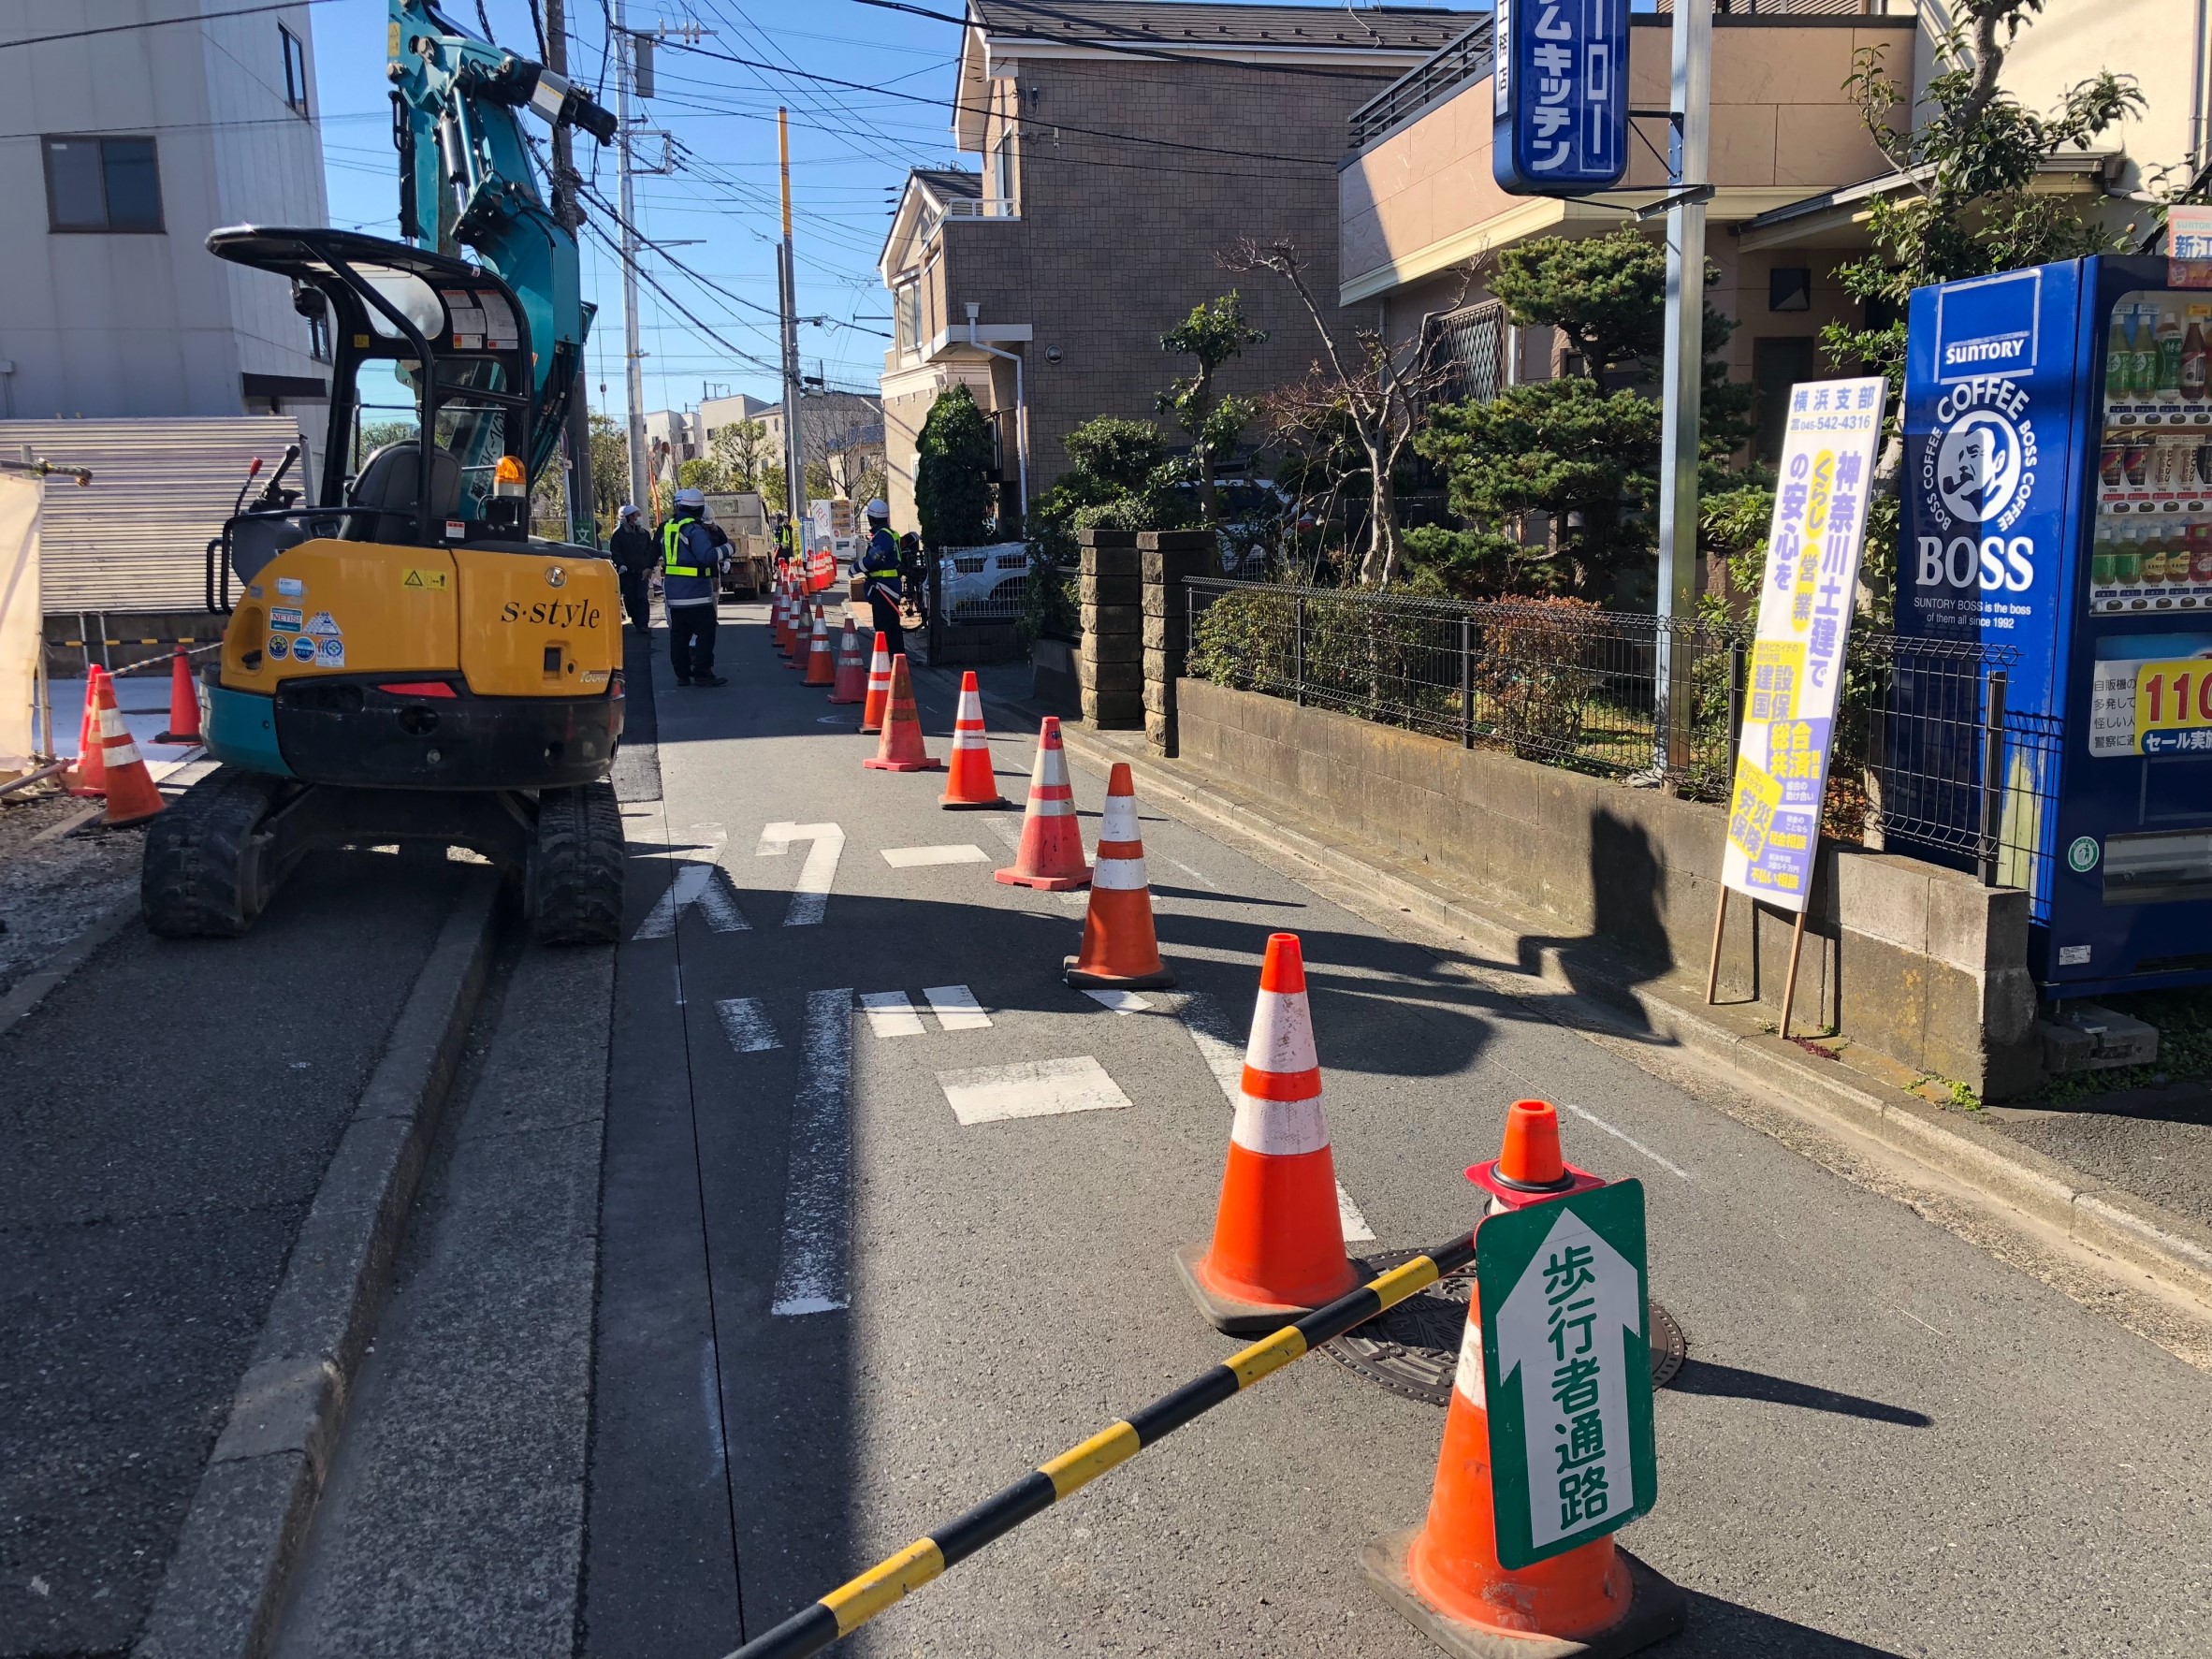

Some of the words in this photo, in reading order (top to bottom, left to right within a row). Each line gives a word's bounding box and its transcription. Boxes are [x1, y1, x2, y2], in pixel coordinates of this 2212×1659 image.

[1532, 0, 1572, 170] ムキッチン
[1945, 339, 2024, 365] SUNTORY
[1794, 386, 1876, 412] 横浜支部
[1937, 377, 2030, 423] COFFEE
[2018, 420, 2037, 467] BOSS
[1773, 452, 1810, 591] の安心を
[1996, 472, 2034, 532] COFFEE
[1809, 451, 1862, 689] 神奈川土建で
[1915, 536, 2034, 591] BOSS
[1914, 597, 1956, 609] SUNTORY
[1957, 600, 1983, 611] BOSS
[1985, 601, 1992, 613] is
[1994, 602, 2007, 614] the
[2010, 603, 2031, 615] boss
[1927, 612, 1935, 622] of
[1936, 613, 1956, 624] them
[1957, 614, 1967, 625] all
[1969, 615, 1991, 627] since
[1993, 618, 2014, 629] 1992
[1542, 1245, 1608, 1531] 歩行者通路
